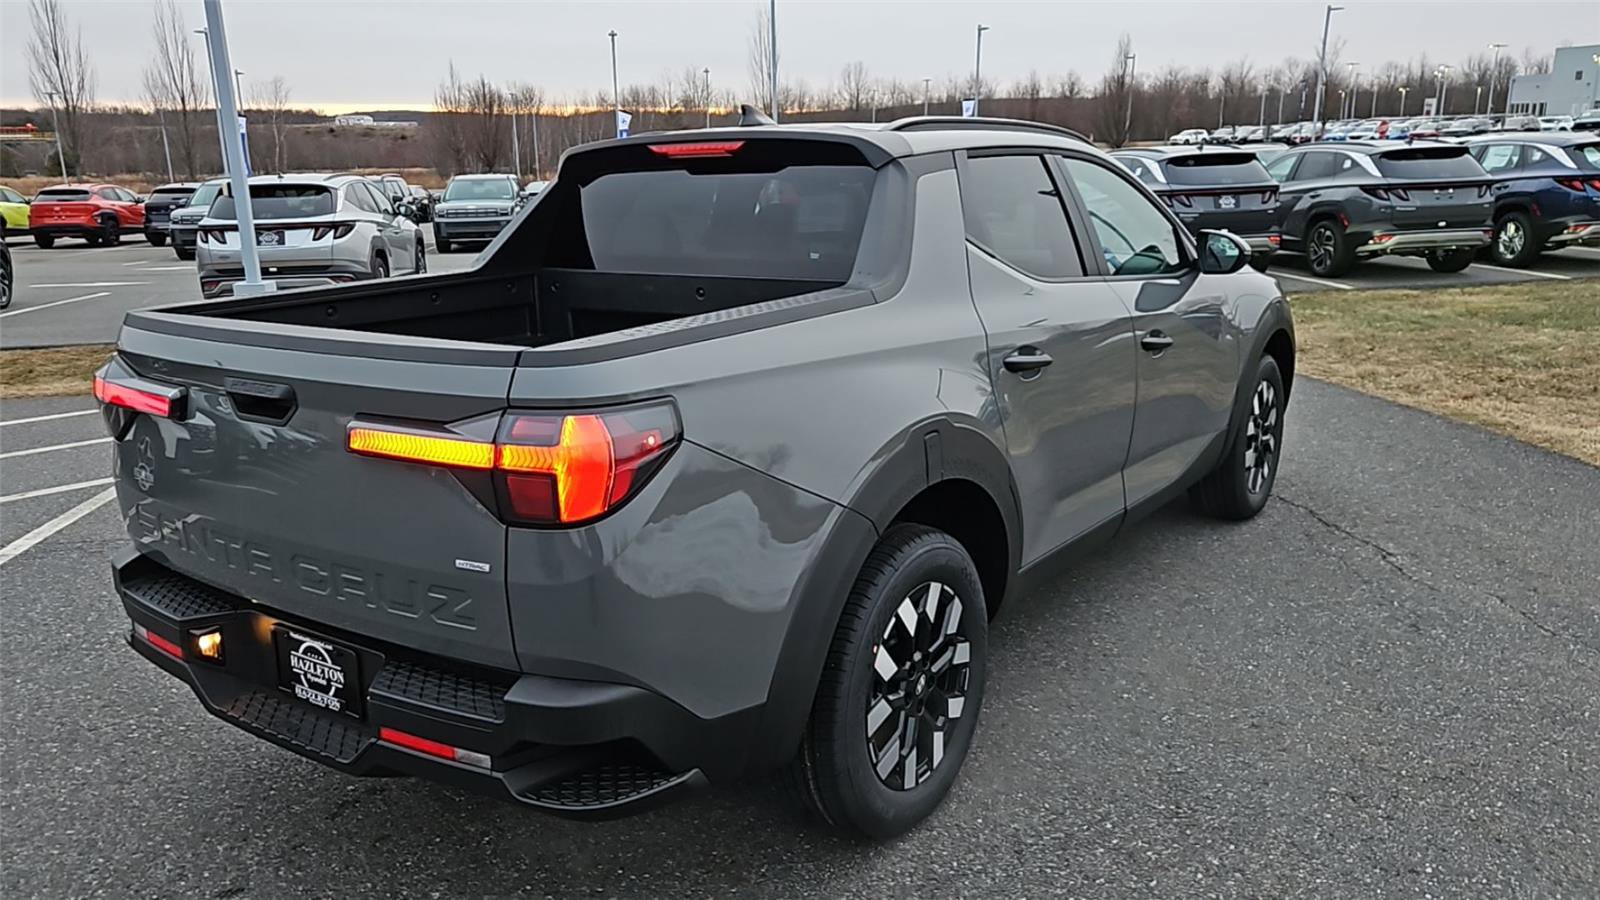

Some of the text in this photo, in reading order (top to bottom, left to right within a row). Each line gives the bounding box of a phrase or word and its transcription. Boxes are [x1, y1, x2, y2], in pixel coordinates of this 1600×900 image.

[135, 502, 477, 631] SANTA CRUZ
[290, 654, 344, 684] HAZLETON
[295, 685, 340, 709] HAZLETON
